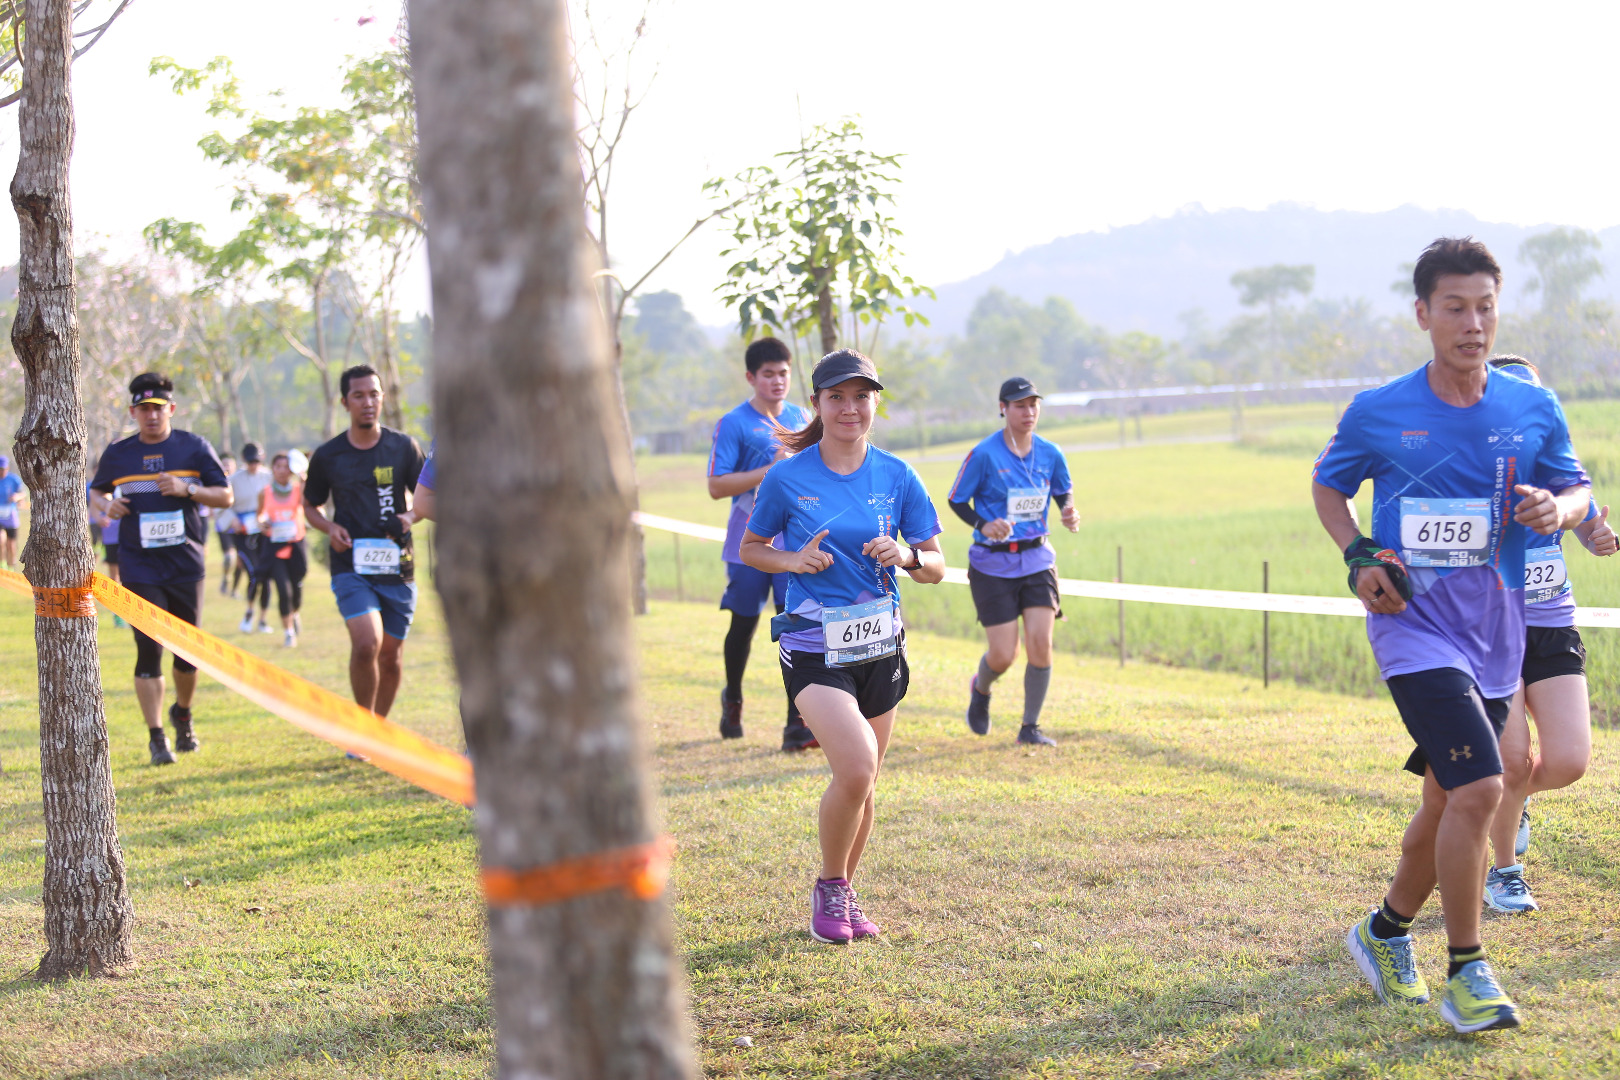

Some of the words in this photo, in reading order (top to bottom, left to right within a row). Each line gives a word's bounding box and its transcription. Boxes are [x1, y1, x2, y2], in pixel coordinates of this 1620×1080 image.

[1487, 435, 1500, 443] SP
[1512, 435, 1524, 443] XC
[1495, 456, 1505, 489] CROSS
[1016, 498, 1044, 511] 6058
[1492, 491, 1503, 535] COUNTRY
[150, 523, 177, 536] 6015
[877, 514, 885, 537] CROS
[1418, 521, 1472, 543] 6158
[364, 550, 392, 562] 6276
[1469, 555, 1480, 566] 16
[843, 618, 882, 643] 6194
[881, 643, 889, 653] 16
